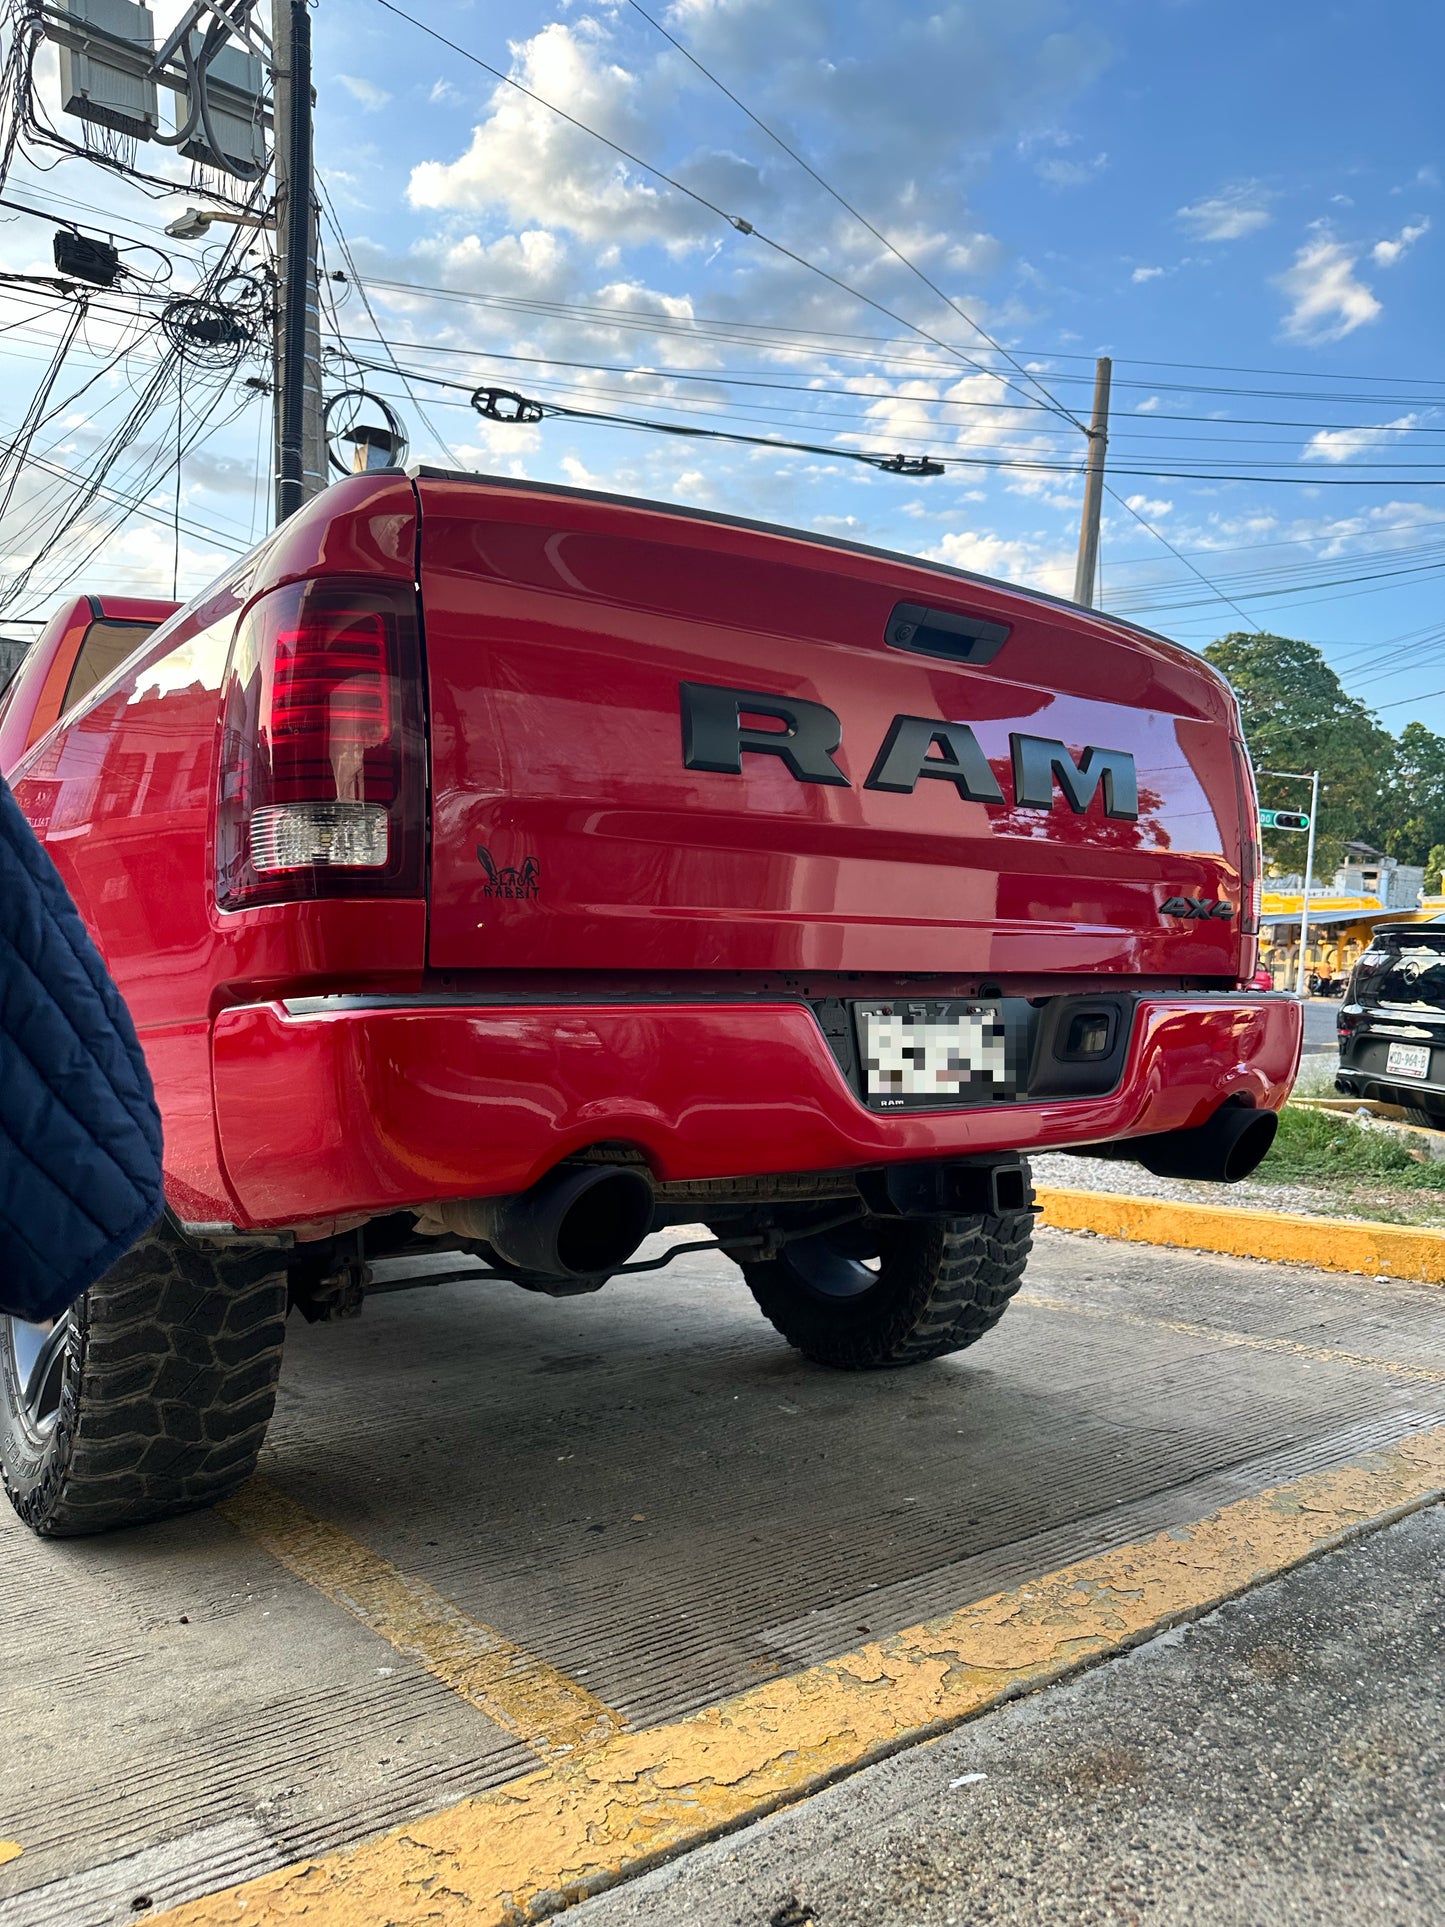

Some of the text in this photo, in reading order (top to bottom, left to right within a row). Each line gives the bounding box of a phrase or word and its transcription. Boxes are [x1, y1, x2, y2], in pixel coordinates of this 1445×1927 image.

[679, 681, 1139, 821] RAM
[490, 872, 536, 886] BLACK
[483, 885, 541, 899] RABBIT
